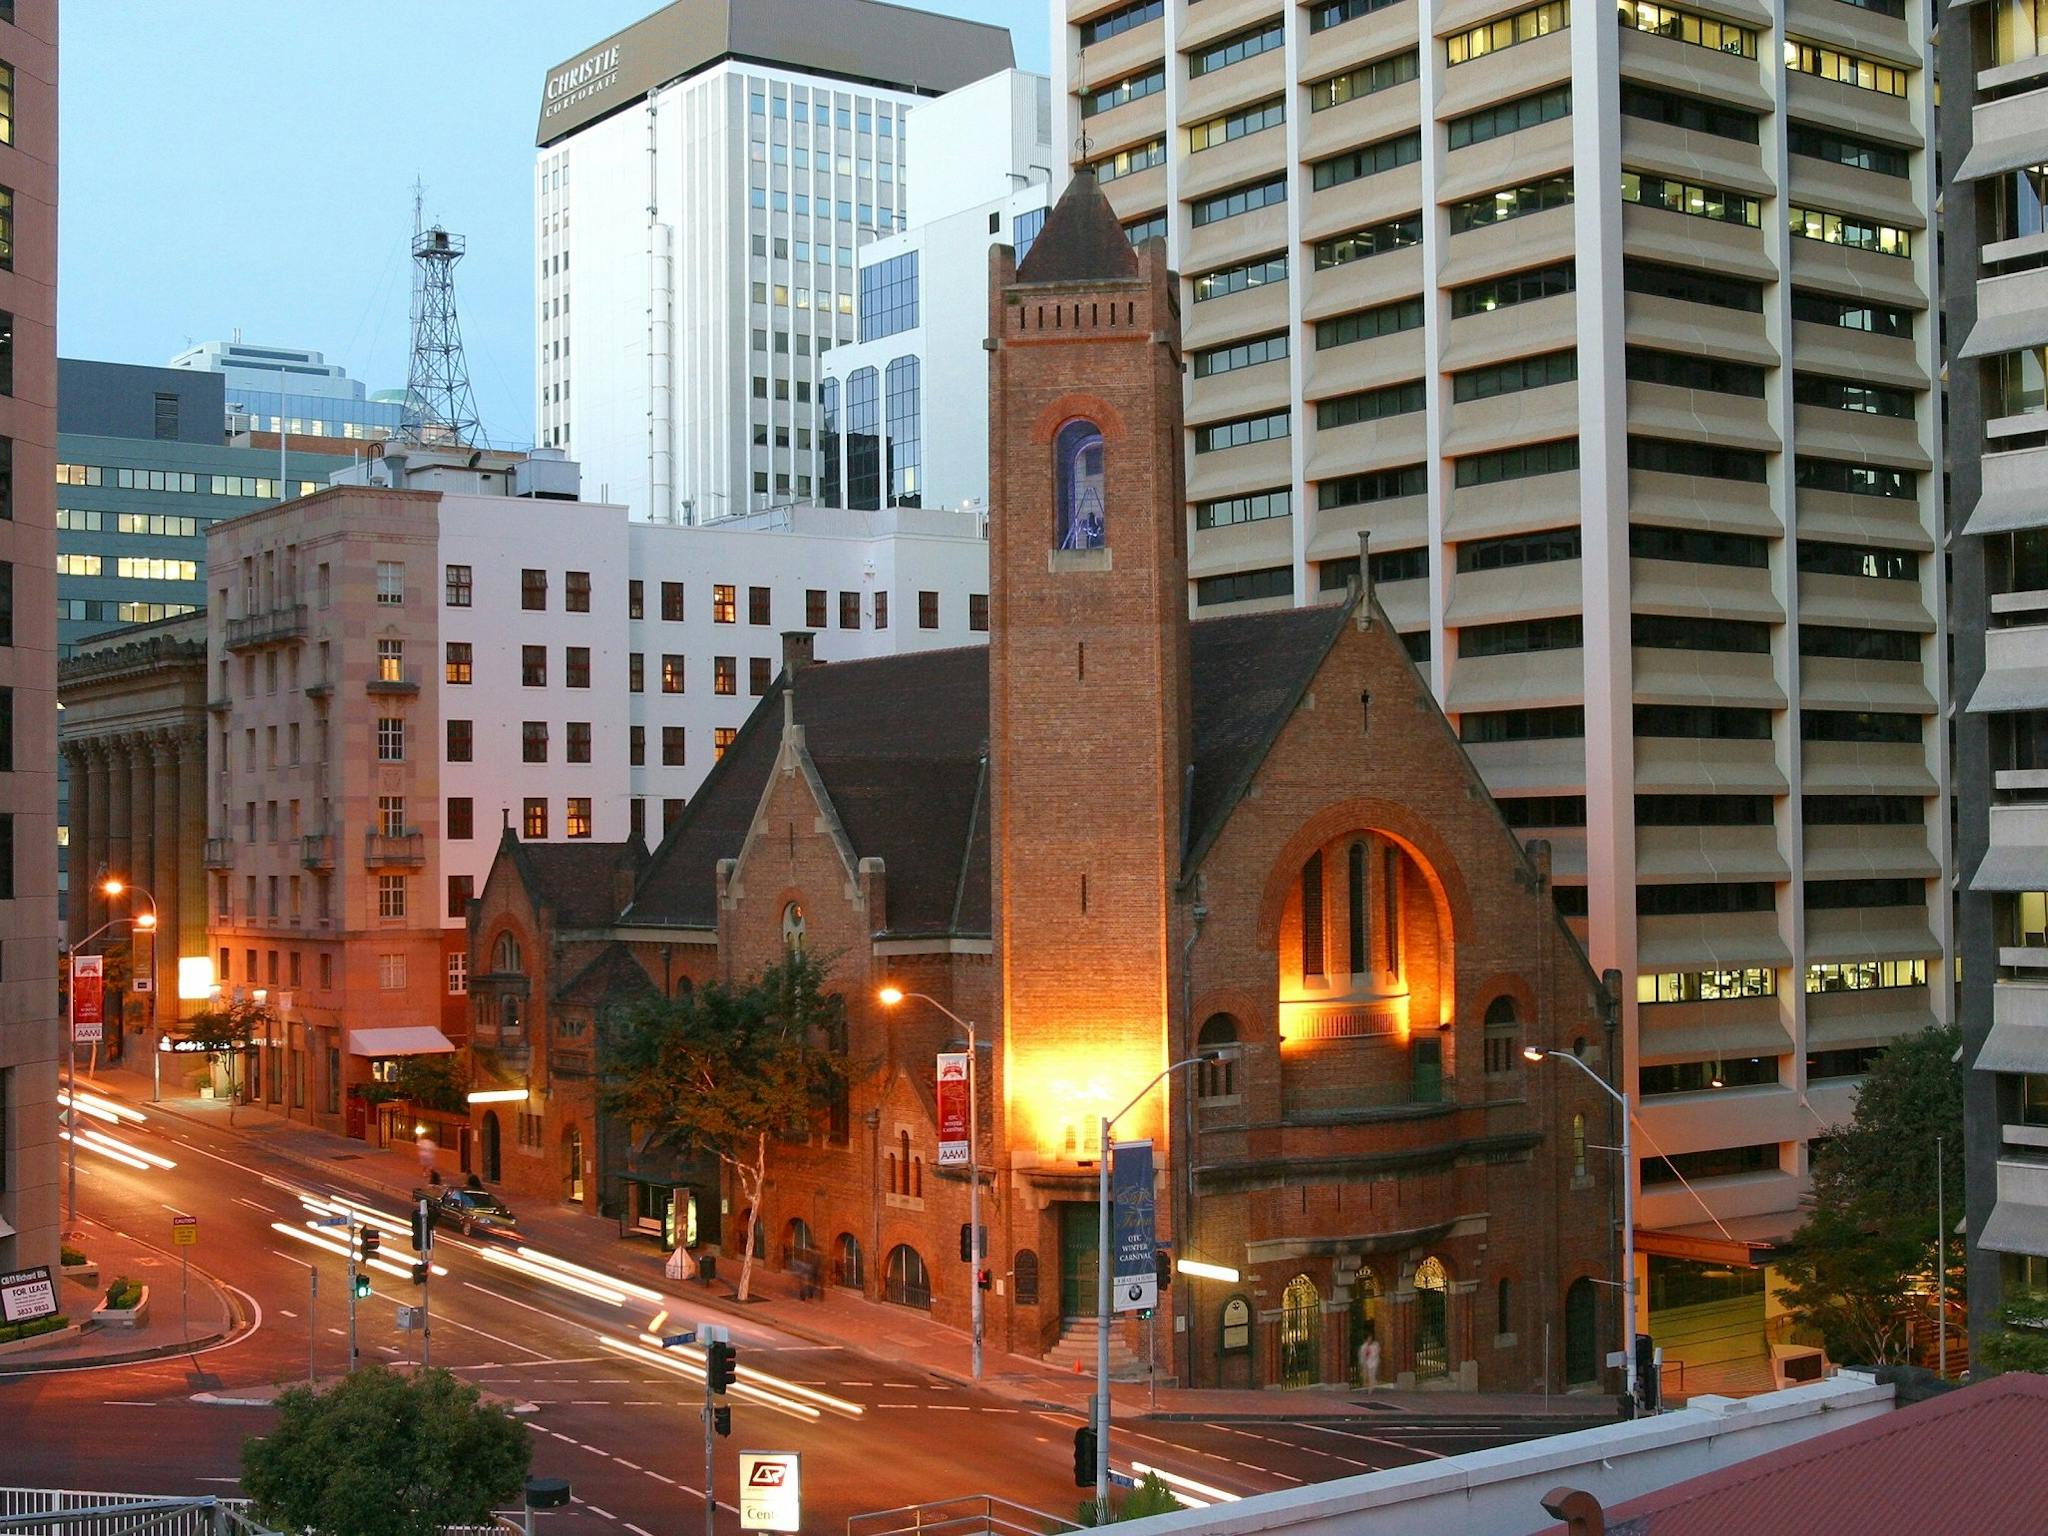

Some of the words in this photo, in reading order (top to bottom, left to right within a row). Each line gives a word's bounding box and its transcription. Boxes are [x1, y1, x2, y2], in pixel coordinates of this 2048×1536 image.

[547, 45, 620, 99] CHRISTIE
[546, 73, 617, 117] CORPORATE
[941, 1148, 966, 1160] AAMI
[1122, 1243, 1148, 1252] WINTER
[1120, 1253, 1152, 1262] CARNIVAL
[13, 1287, 27, 1297] FOR
[28, 1283, 49, 1294] LEASE
